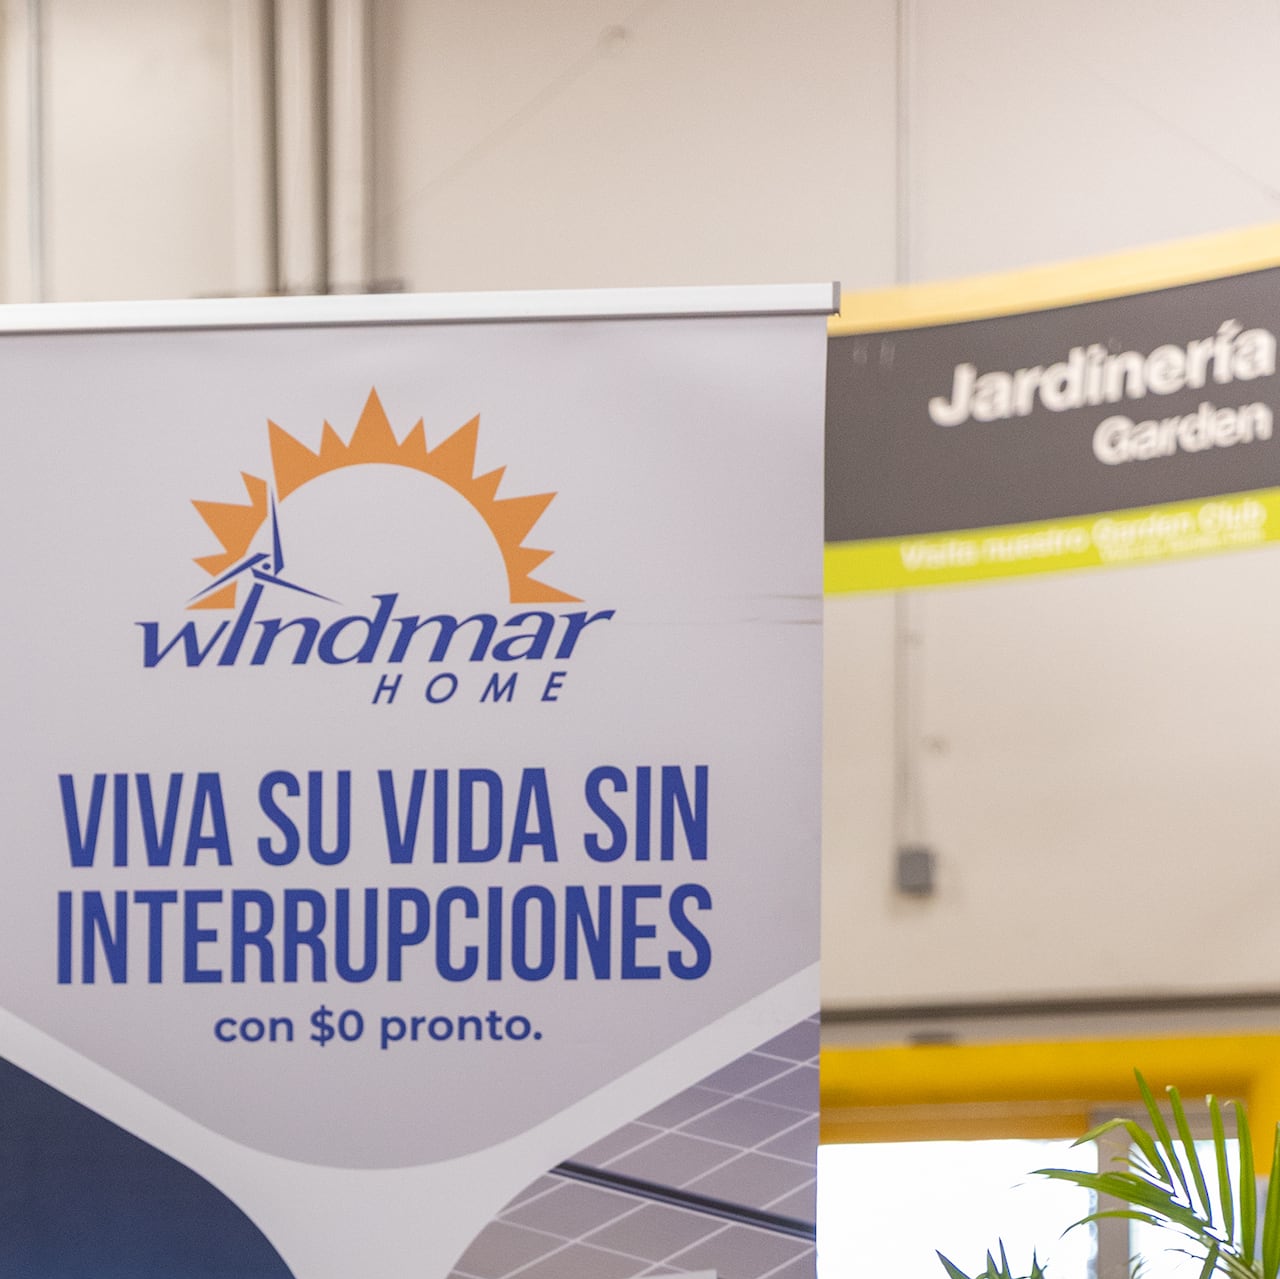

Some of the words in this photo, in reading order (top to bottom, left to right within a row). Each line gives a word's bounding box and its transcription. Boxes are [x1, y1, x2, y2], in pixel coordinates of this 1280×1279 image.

[928, 319, 1276, 427] Jardinería
[1092, 402, 1274, 465] Garden
[134, 582, 617, 669] windmar
[371, 671, 569, 705] HOME
[57, 771, 234, 868] VIVA
[256, 769, 352, 866] SU
[377, 767, 559, 865] VIDA
[583, 764, 710, 863] SIN
[56, 883, 714, 985] INTERRUPCIONES
[213, 1016, 295, 1043] con
[309, 1004, 365, 1047] $0
[379, 1009, 543, 1050] pronto.
